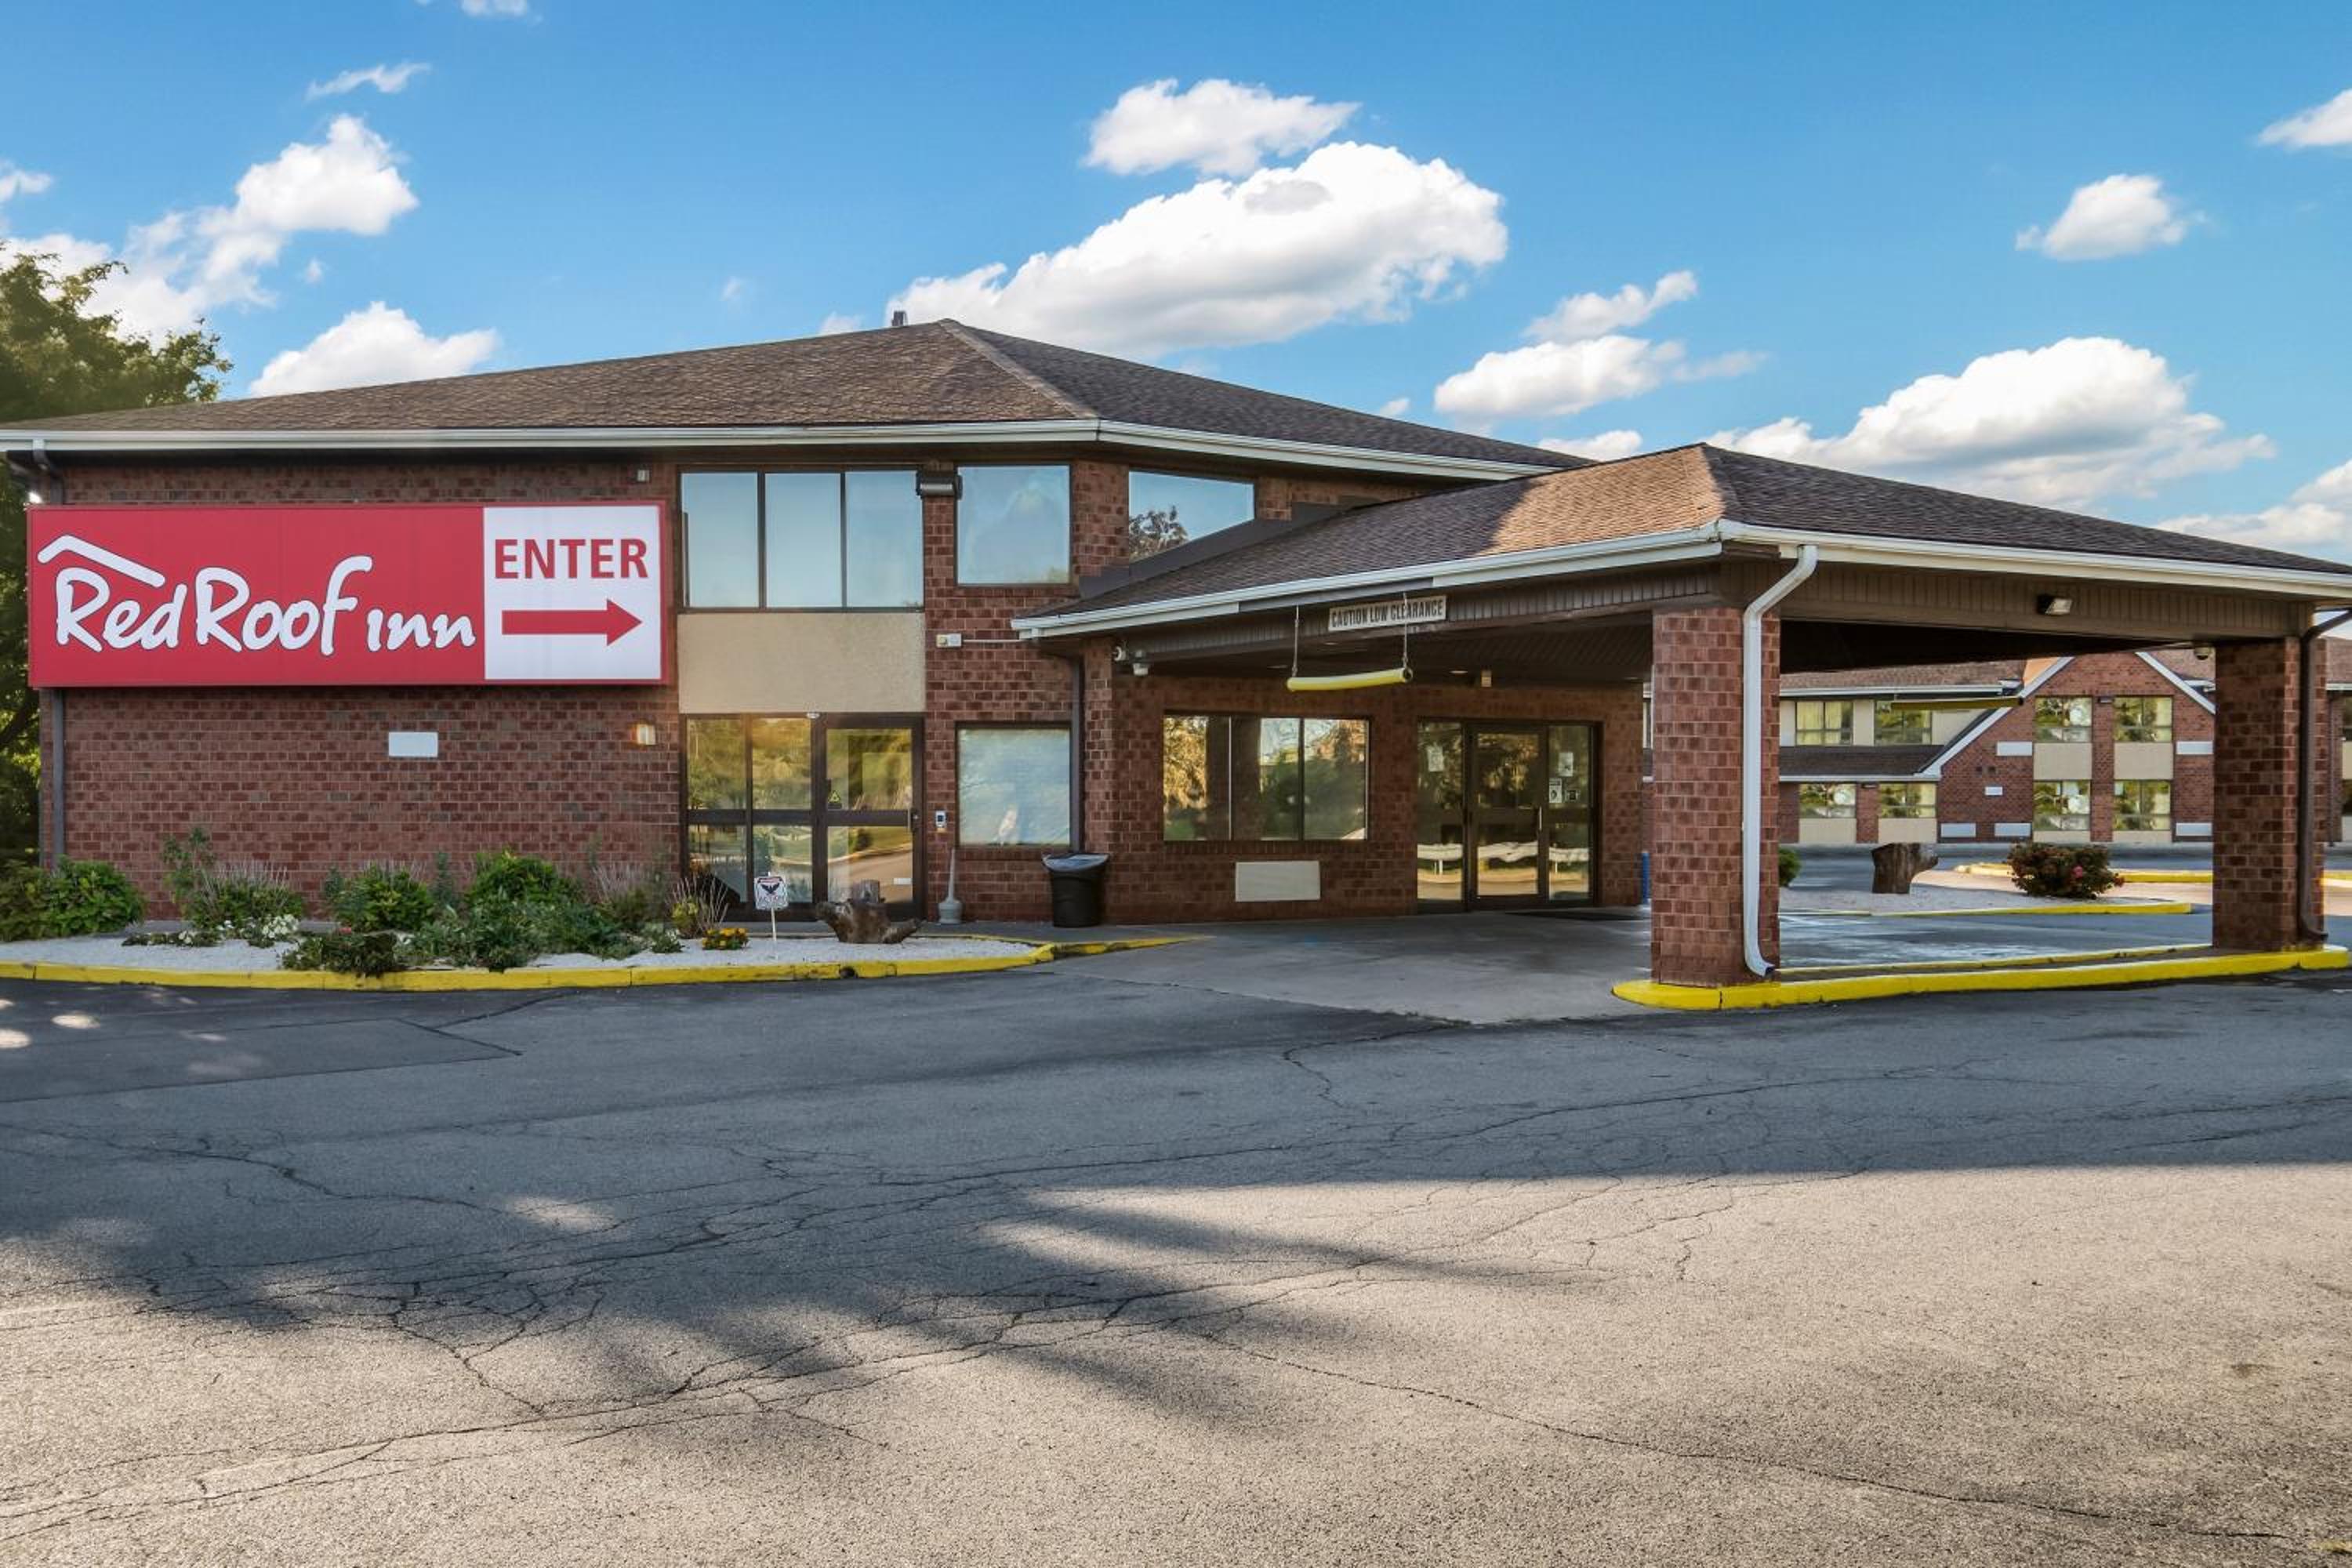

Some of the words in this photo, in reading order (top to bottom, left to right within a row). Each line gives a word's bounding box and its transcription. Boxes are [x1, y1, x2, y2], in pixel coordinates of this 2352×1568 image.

[495, 539, 648, 578] ENTER
[55, 567, 188, 653] Red
[195, 555, 373, 656] Roof
[1331, 608, 1368, 627] CAUTION
[1370, 605, 1388, 622] LOW
[1390, 600, 1443, 620] CLEARANCE
